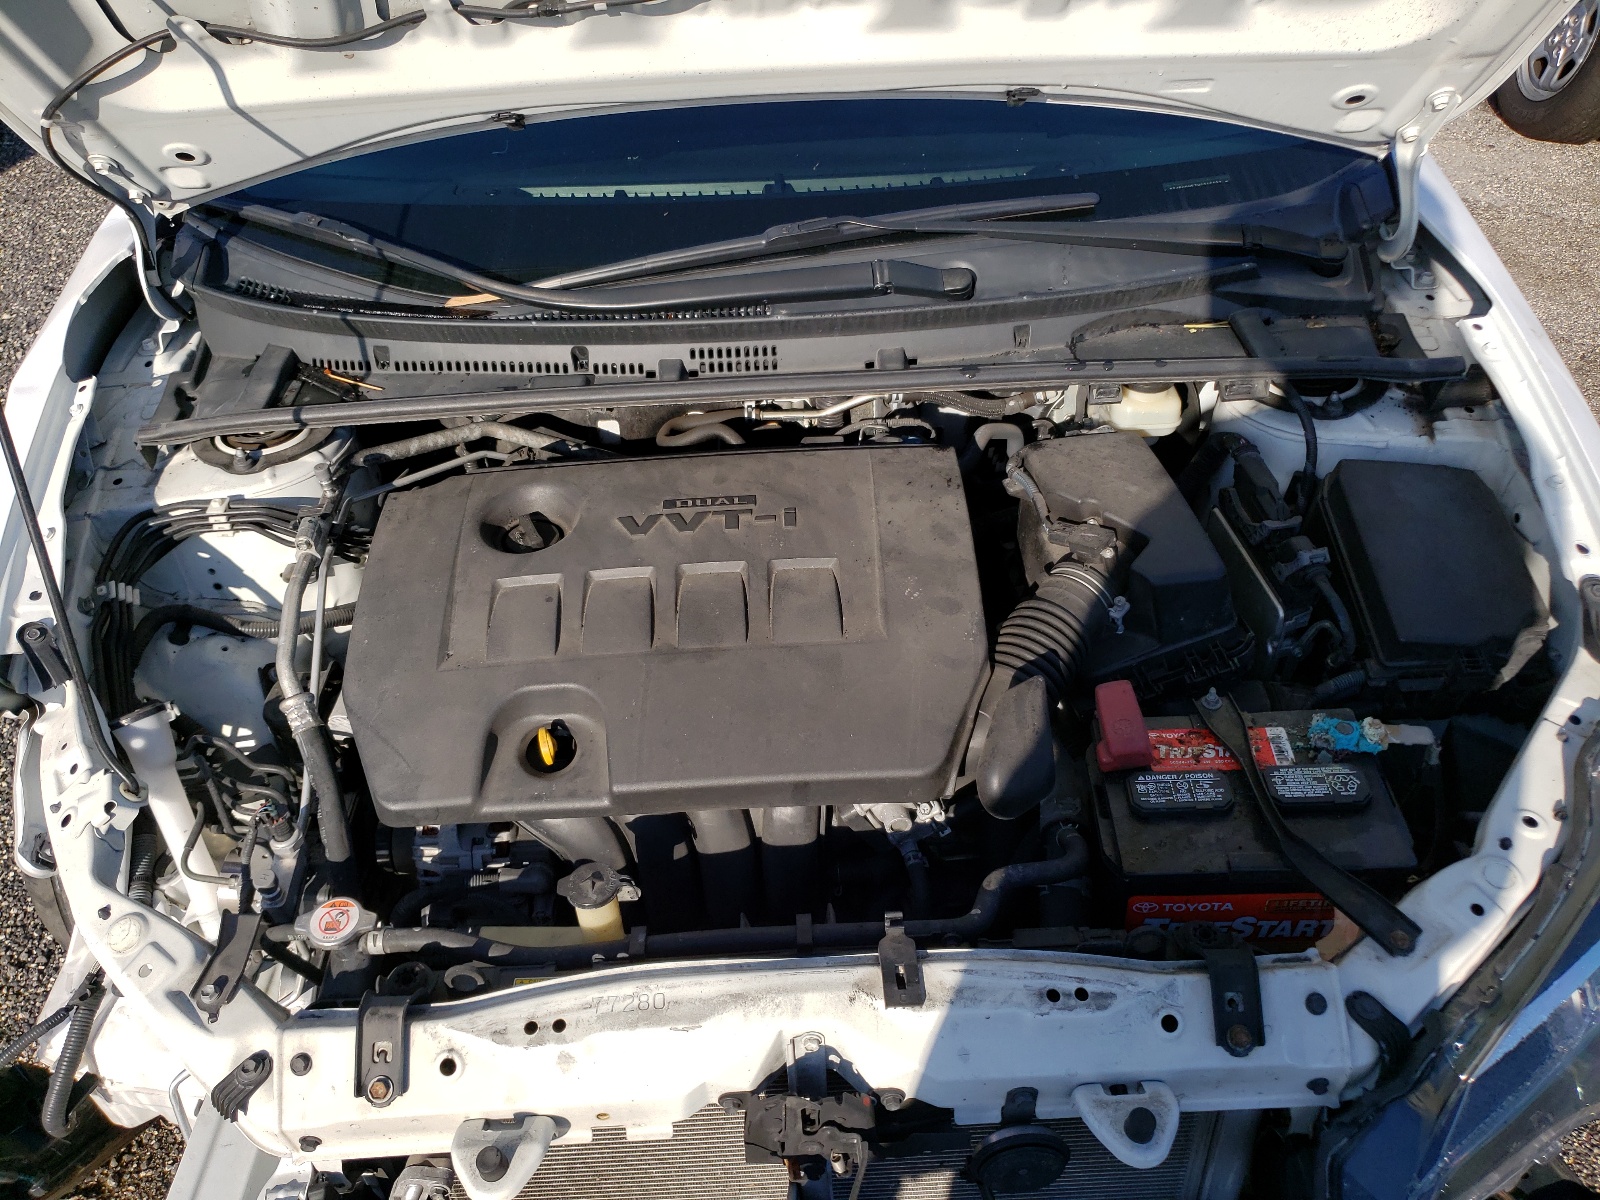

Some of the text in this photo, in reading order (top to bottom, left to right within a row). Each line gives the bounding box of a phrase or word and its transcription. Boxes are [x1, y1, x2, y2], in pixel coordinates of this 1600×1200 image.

[675, 496, 748, 508] DUAL
[1162, 902, 1234, 912] TOYOTA
[591, 992, 666, 1014] 77280
